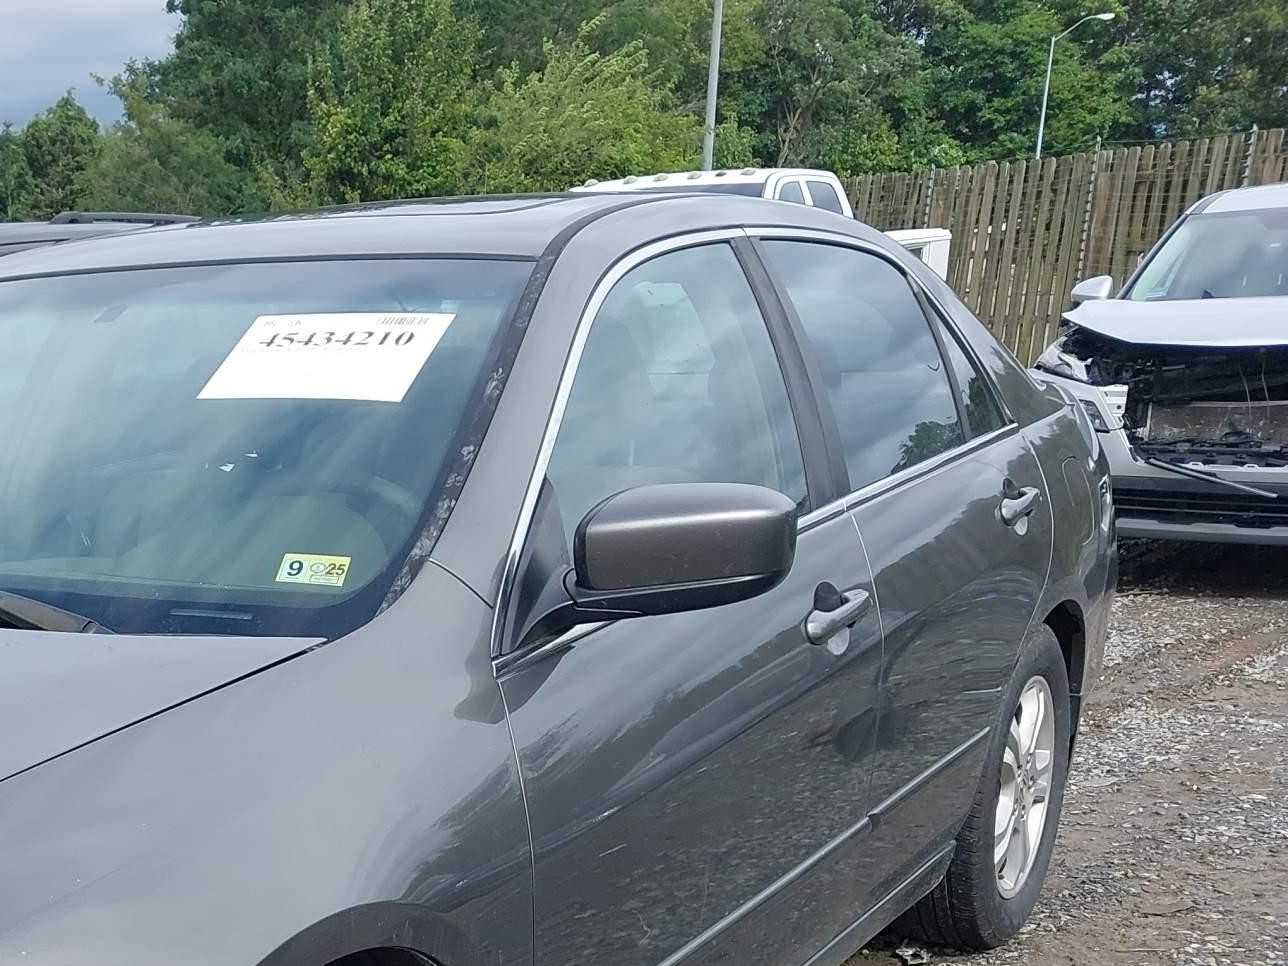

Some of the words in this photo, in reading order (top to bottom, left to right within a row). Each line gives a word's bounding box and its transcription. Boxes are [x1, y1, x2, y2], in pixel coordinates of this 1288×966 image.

[259, 331, 415, 347] 45434210
[287, 560, 304, 576] 9
[325, 563, 347, 576] 25
